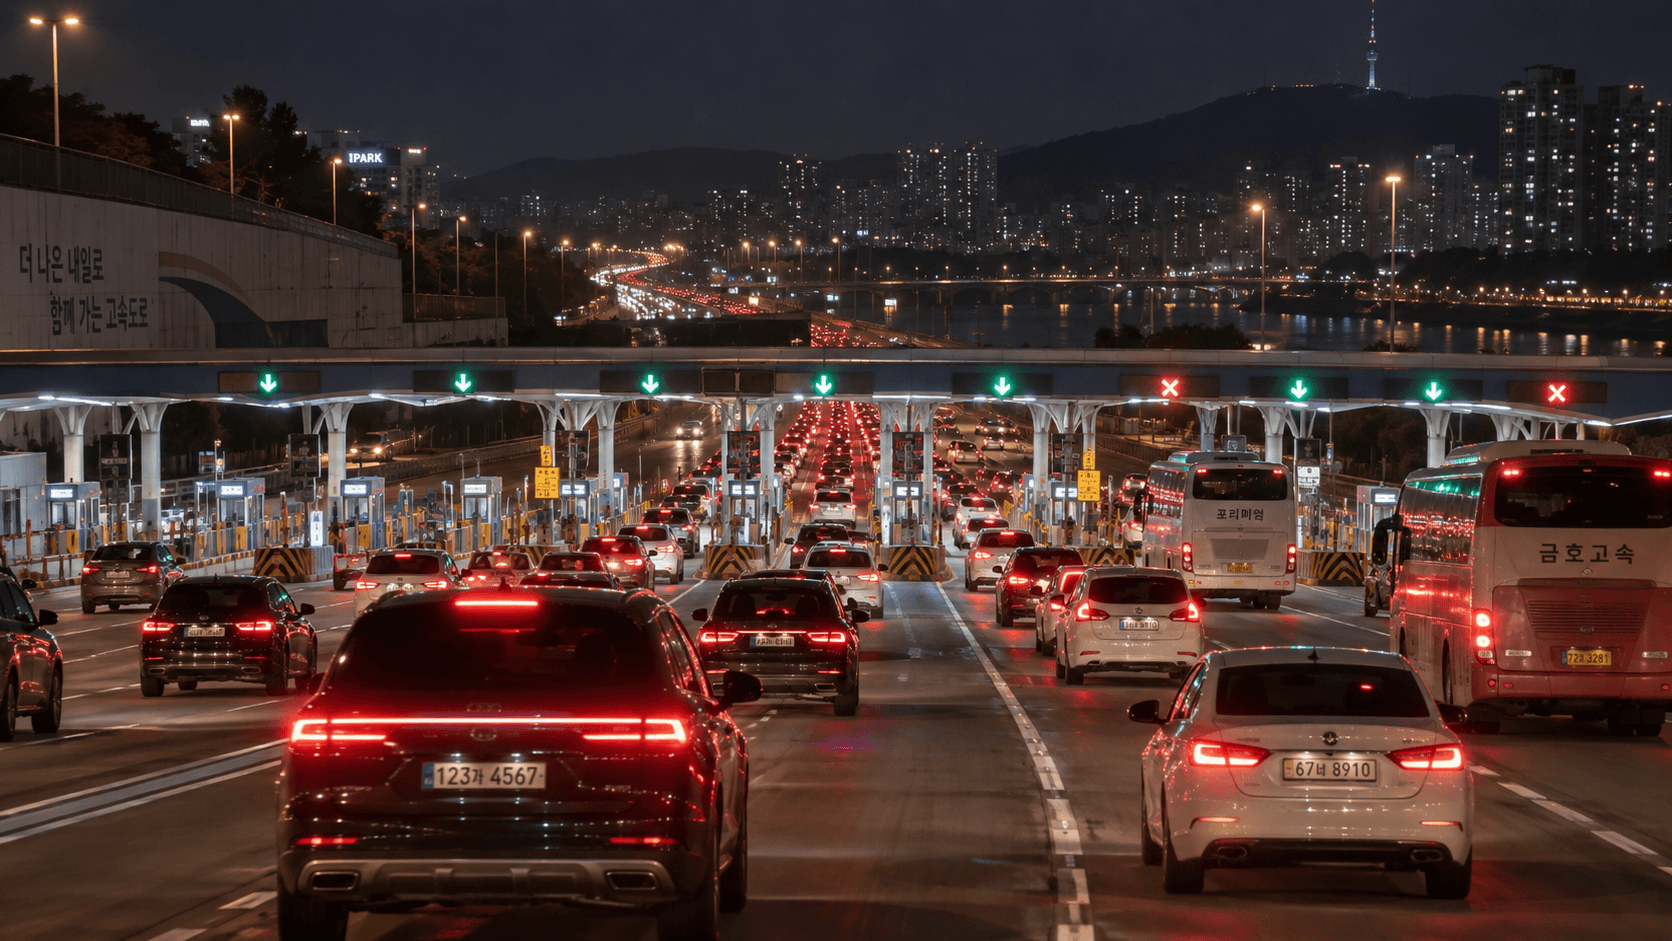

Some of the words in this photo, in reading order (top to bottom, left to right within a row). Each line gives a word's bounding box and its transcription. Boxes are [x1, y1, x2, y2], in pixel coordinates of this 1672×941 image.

[19, 243, 32, 284] 더
[37, 244, 64, 284] 나은
[68, 245, 104, 284] 내일로
[79, 296, 102, 334] 가는
[106, 295, 149, 332] 고속도로
[1539, 543, 1635, 565] 금호고속
[1587, 652, 1609, 665] 3281
[437, 766, 484, 786] 123가
[490, 766, 538, 786] 4567
[1332, 762, 1371, 778] 8910
